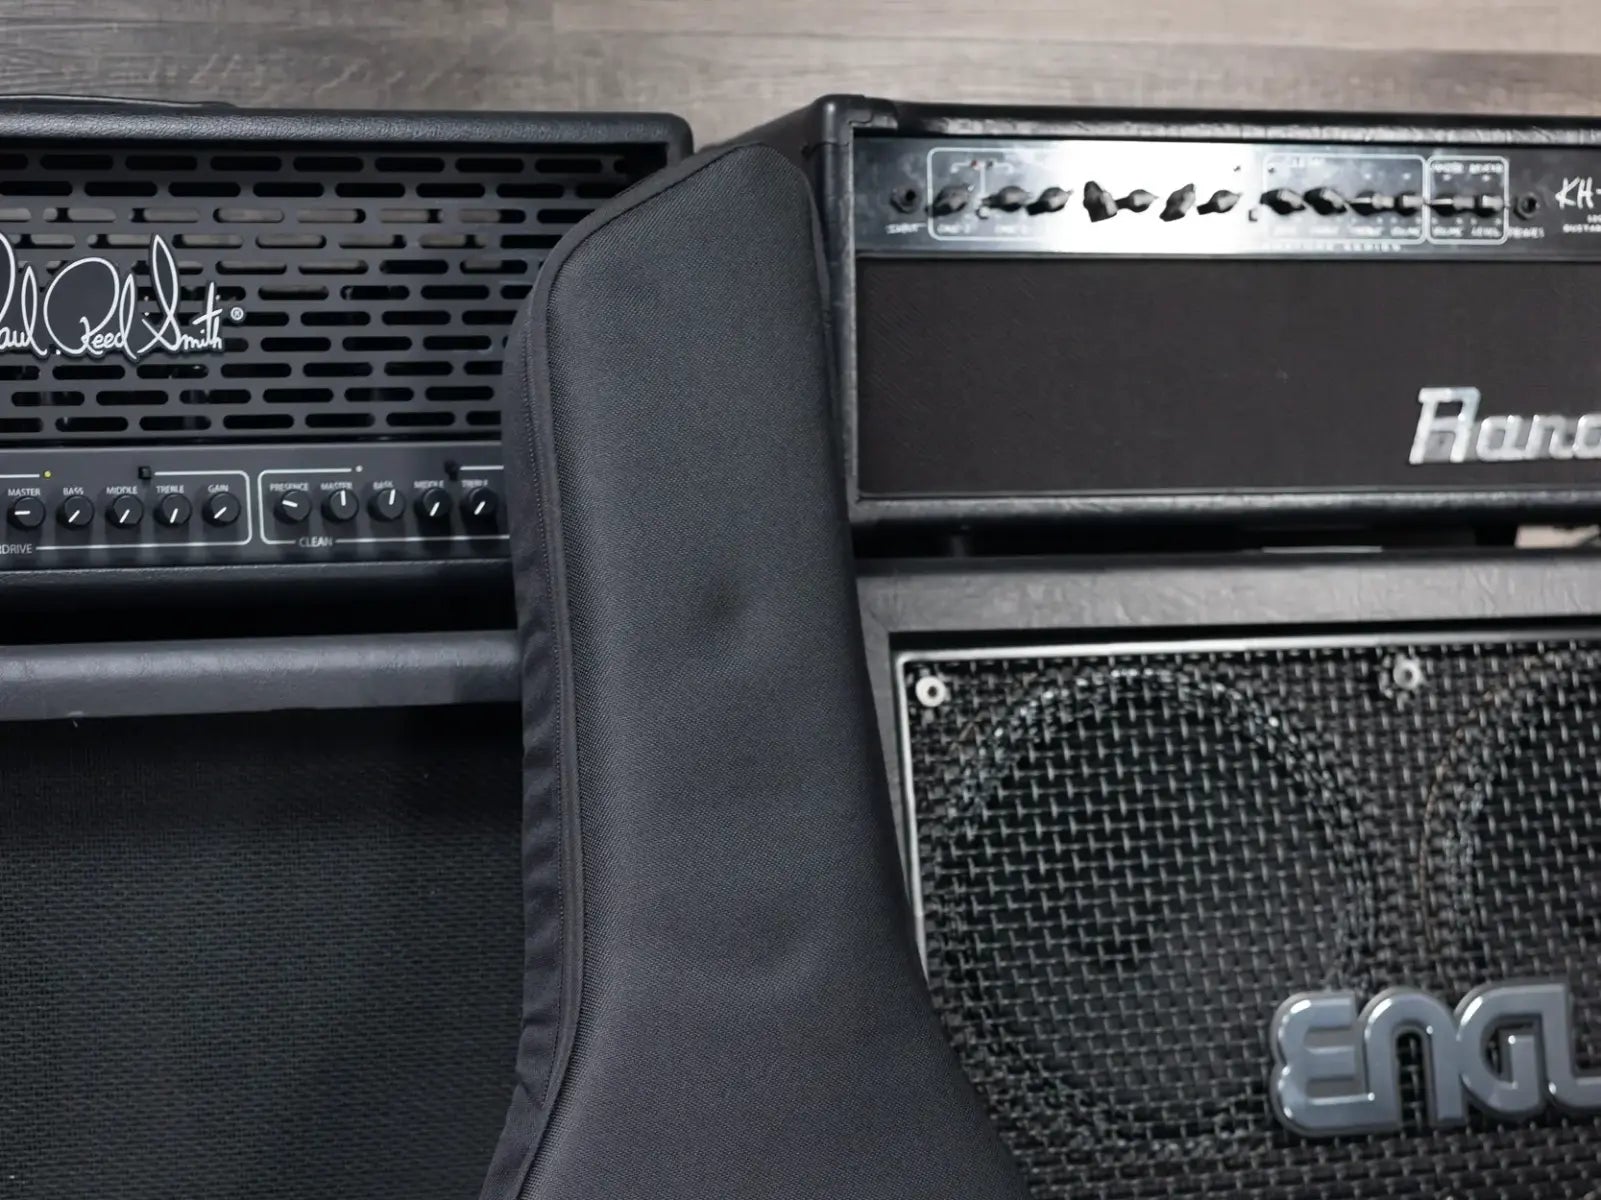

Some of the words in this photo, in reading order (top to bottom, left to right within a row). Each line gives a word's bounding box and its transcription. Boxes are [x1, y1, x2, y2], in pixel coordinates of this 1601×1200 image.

[43, 257, 138, 360] Reed
[62, 487, 84, 496] BASS
[106, 486, 138, 495] MIDDLE
[208, 484, 229, 493] GAIN
[269, 482, 309, 492] PRESENCE
[7, 488, 41, 497] MASTER
[298, 536, 333, 547] CLEAN
